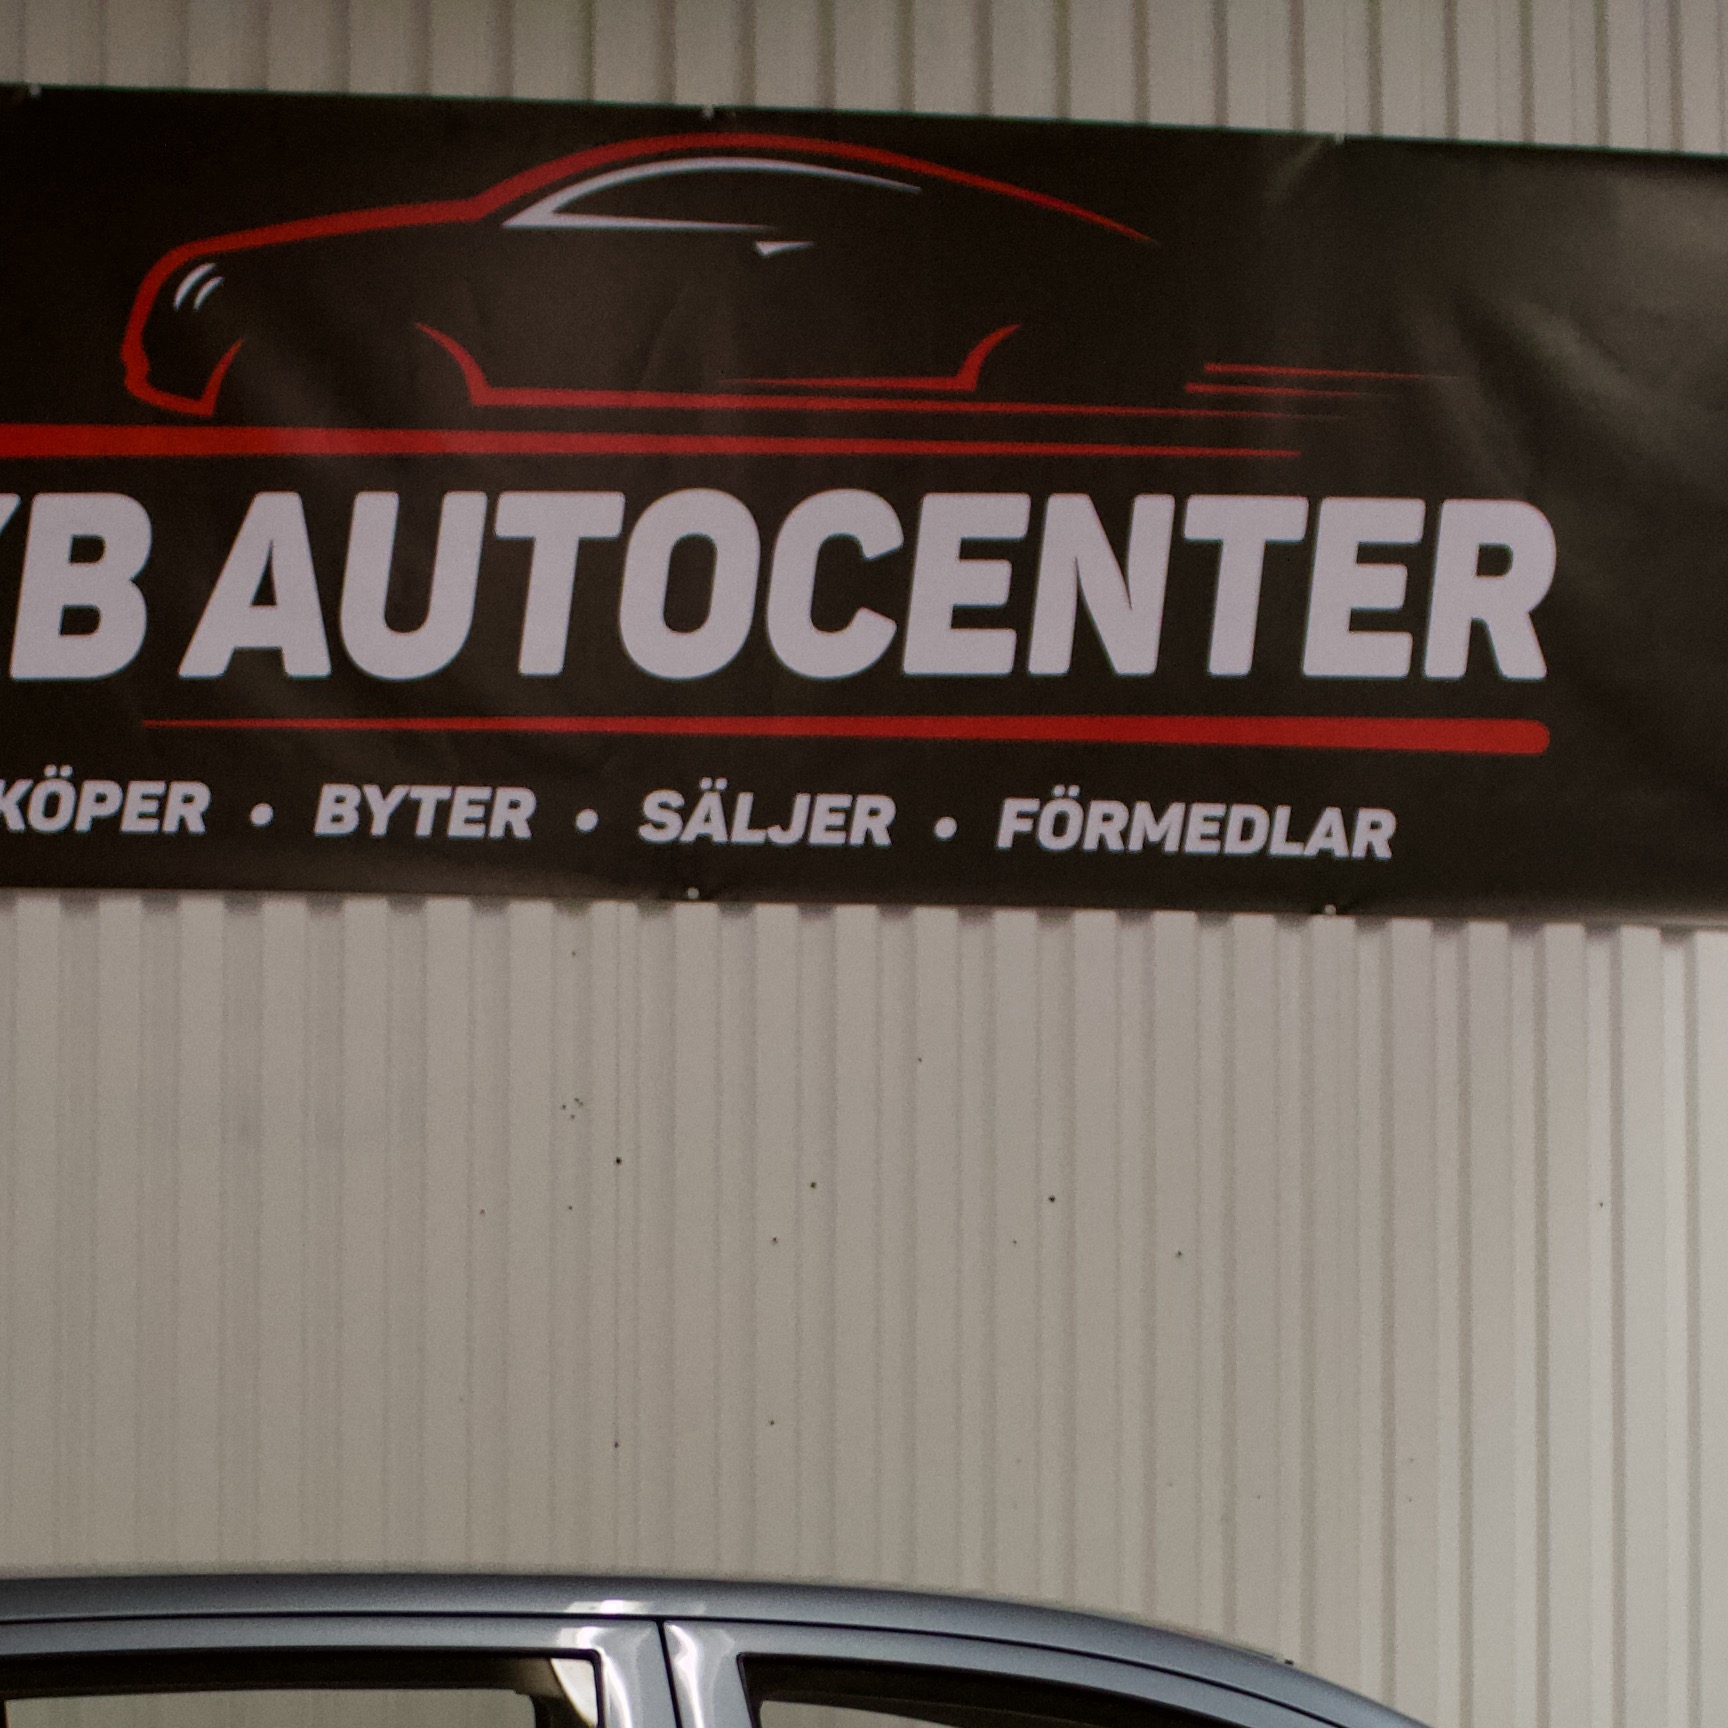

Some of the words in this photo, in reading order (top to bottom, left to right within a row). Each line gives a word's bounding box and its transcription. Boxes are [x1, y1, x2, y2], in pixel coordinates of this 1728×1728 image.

[179, 489, 1557, 680] AUTOCENTER
[314, 784, 536, 838] BYTER
[638, 776, 896, 845] SÄLJER
[997, 784, 1396, 858] FÖRMEDLAR
